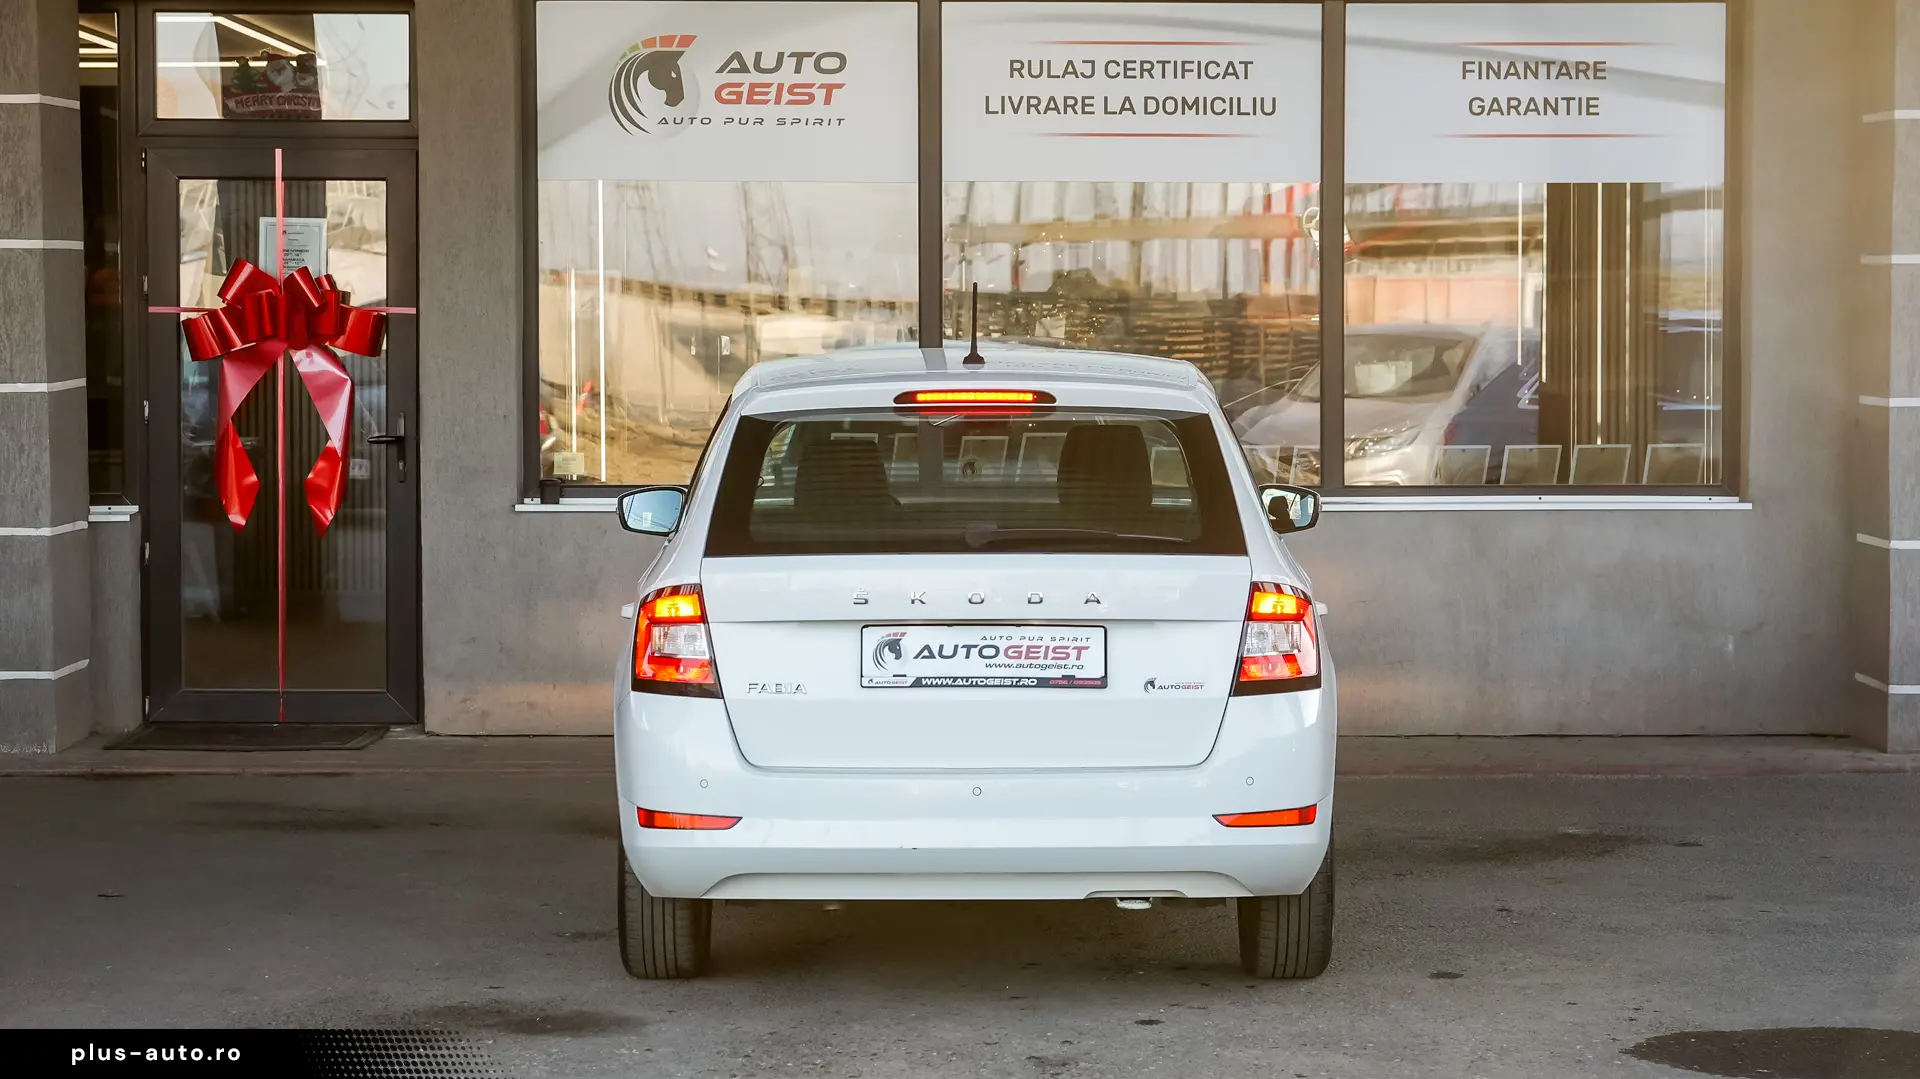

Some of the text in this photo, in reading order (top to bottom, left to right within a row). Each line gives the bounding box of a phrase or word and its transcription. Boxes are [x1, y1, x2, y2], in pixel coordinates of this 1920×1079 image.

[715, 50, 848, 75] AUTO
[1008, 59, 1254, 81] RULAJ CERTIFICAT
[1461, 60, 1607, 81] FINANTARE
[713, 82, 847, 107] GEIST
[984, 95, 1278, 117] LIVRARE LA DOMICILIU
[1468, 96, 1600, 117] GARANTIE
[656, 116, 847, 128] AUTO PUR SPIRIT
[985, 661, 1085, 671] www.autogeist.ro
[746, 682, 808, 695] FABIA
[921, 677, 1038, 687] WWW.AUTOGEIST.RO
